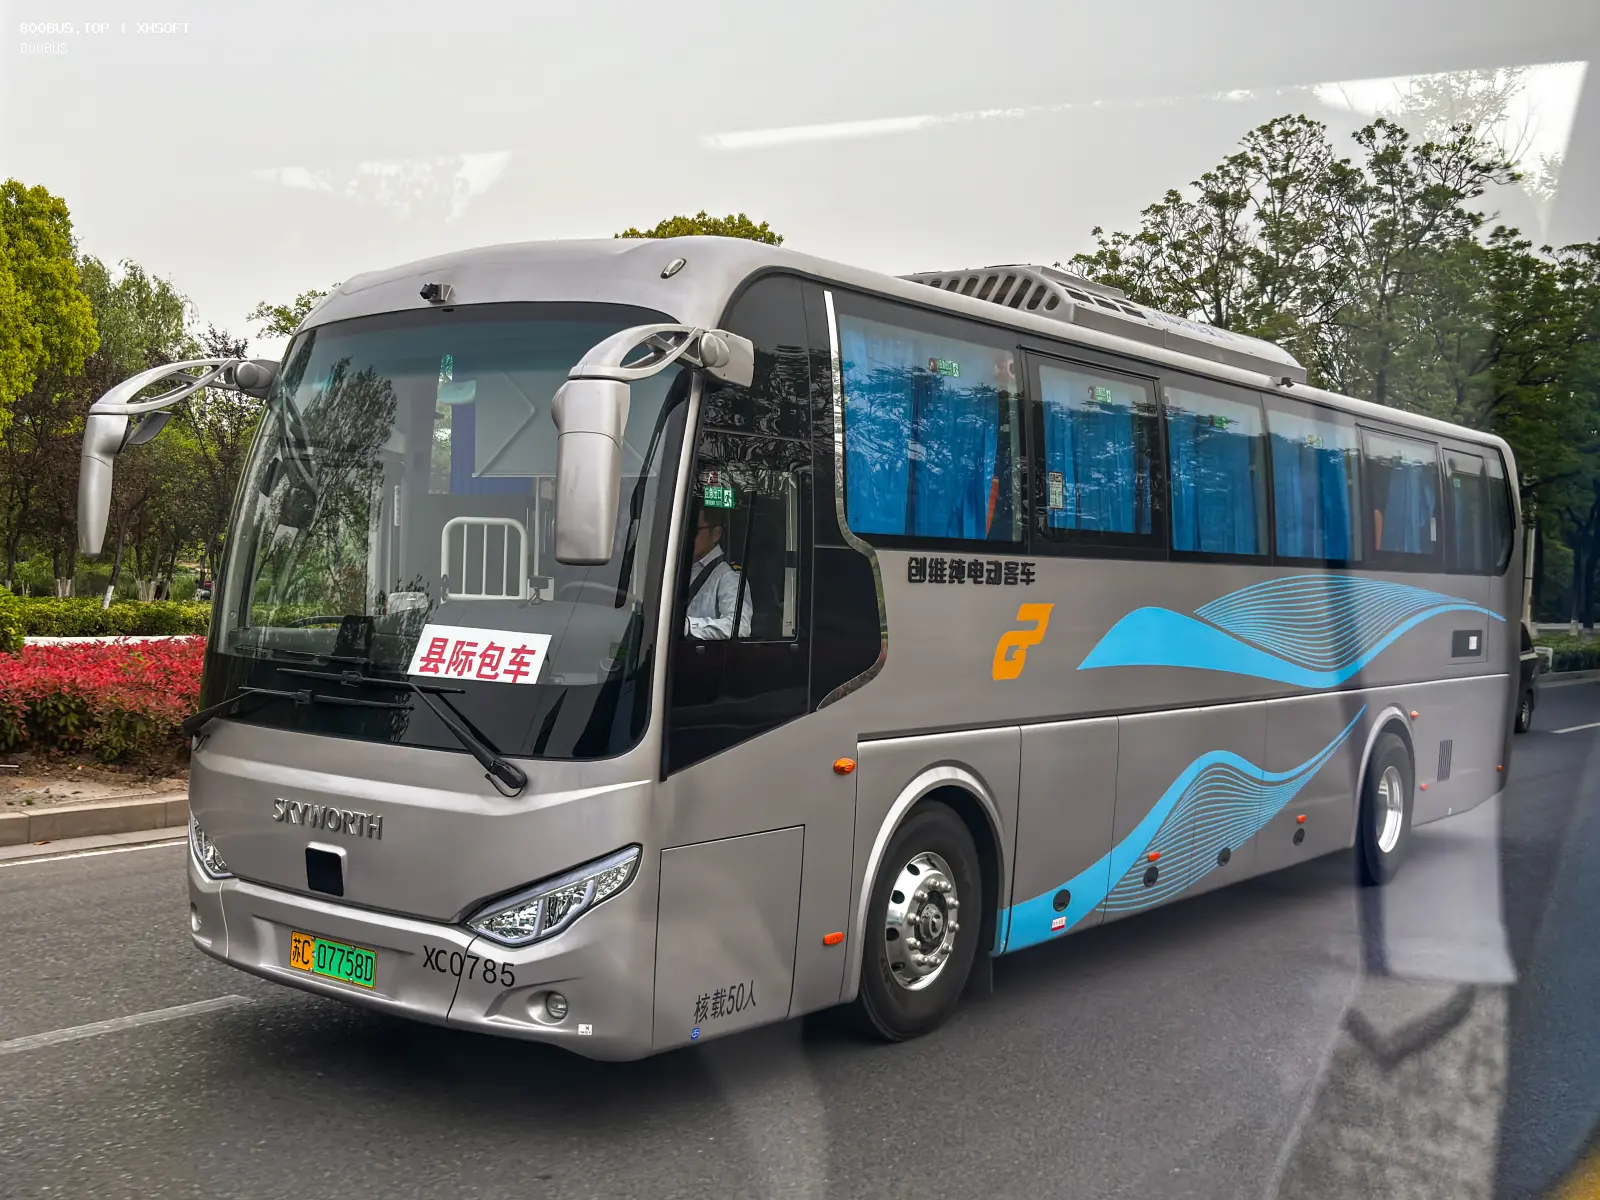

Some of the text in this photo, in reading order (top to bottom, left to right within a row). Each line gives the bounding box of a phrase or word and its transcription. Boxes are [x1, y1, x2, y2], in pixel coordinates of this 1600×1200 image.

[907, 556, 1036, 586] 创维纯电动客车
[418, 636, 537, 684] 县际包车
[272, 798, 383, 840] SKYWORTH
[422, 945, 516, 988] XC0785
[693, 979, 757, 1025] 核载50人
